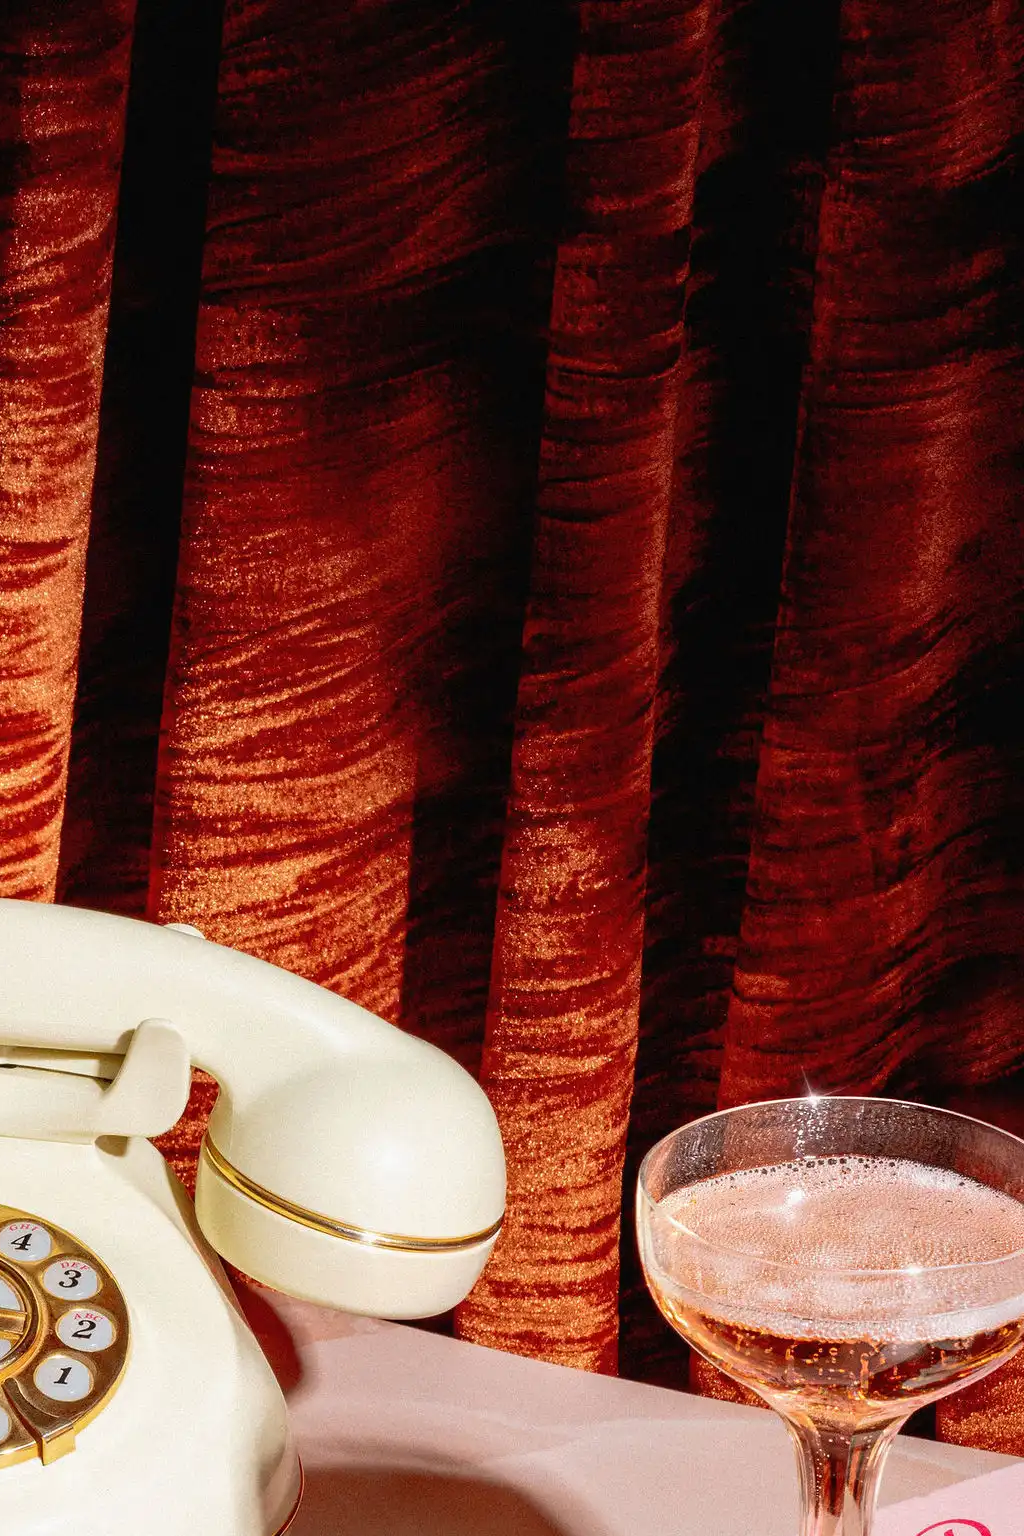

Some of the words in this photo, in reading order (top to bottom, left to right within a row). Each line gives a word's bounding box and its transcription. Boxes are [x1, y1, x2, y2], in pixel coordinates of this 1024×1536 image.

[9, 1223, 39, 1232] GHI
[10, 1233, 33, 1251] 4
[61, 1262, 90, 1271] DEF
[58, 1269, 82, 1288] 3
[73, 1313, 103, 1323] ABC
[71, 1319, 97, 1339] 2
[53, 1366, 72, 1385] 1
